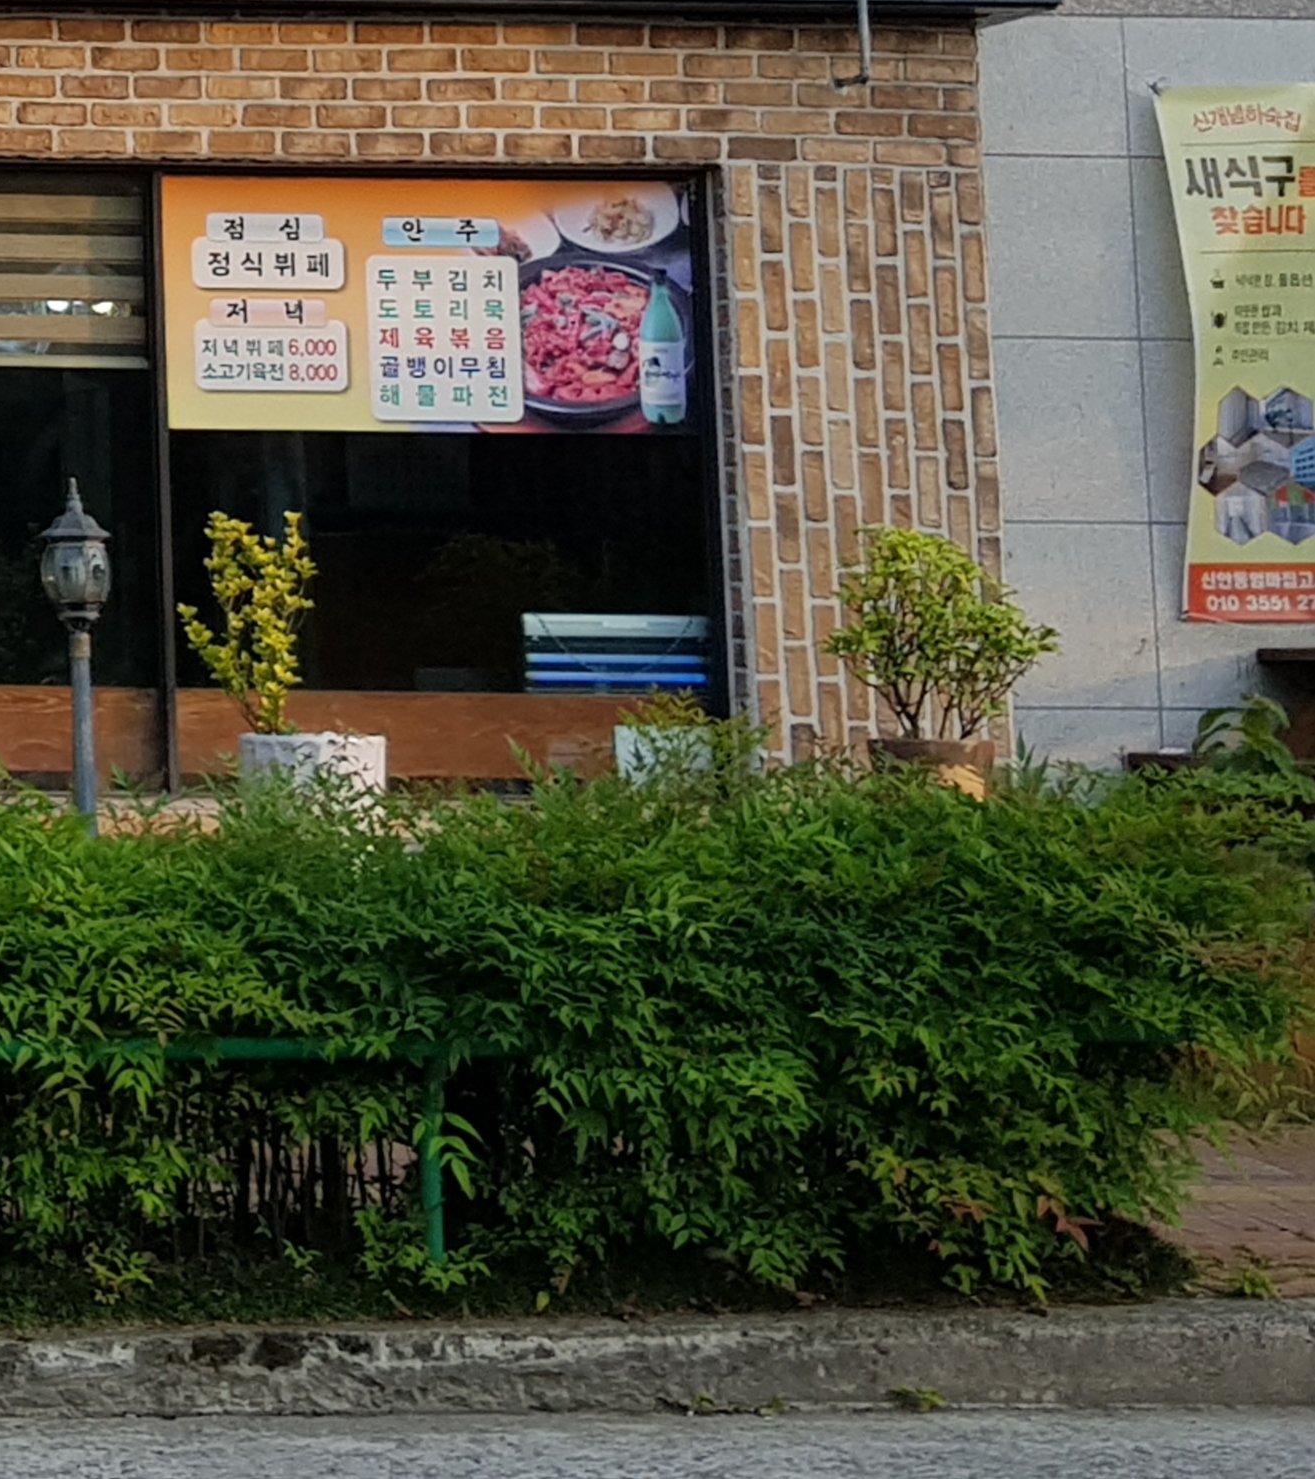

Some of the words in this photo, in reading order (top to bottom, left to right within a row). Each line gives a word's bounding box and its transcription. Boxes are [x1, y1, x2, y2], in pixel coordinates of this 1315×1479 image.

[1211, 205, 1306, 235] 찾습니다
[377, 269, 503, 292] 두부김치
[378, 299, 504, 320] 도토리묵
[379, 327, 506, 349] 제육볶음
[202, 363, 284, 381] 소고기육전
[380, 356, 506, 379] 골뱅이무침
[380, 384, 508, 407] 해물파전
[1206, 595, 1240, 611] 010
